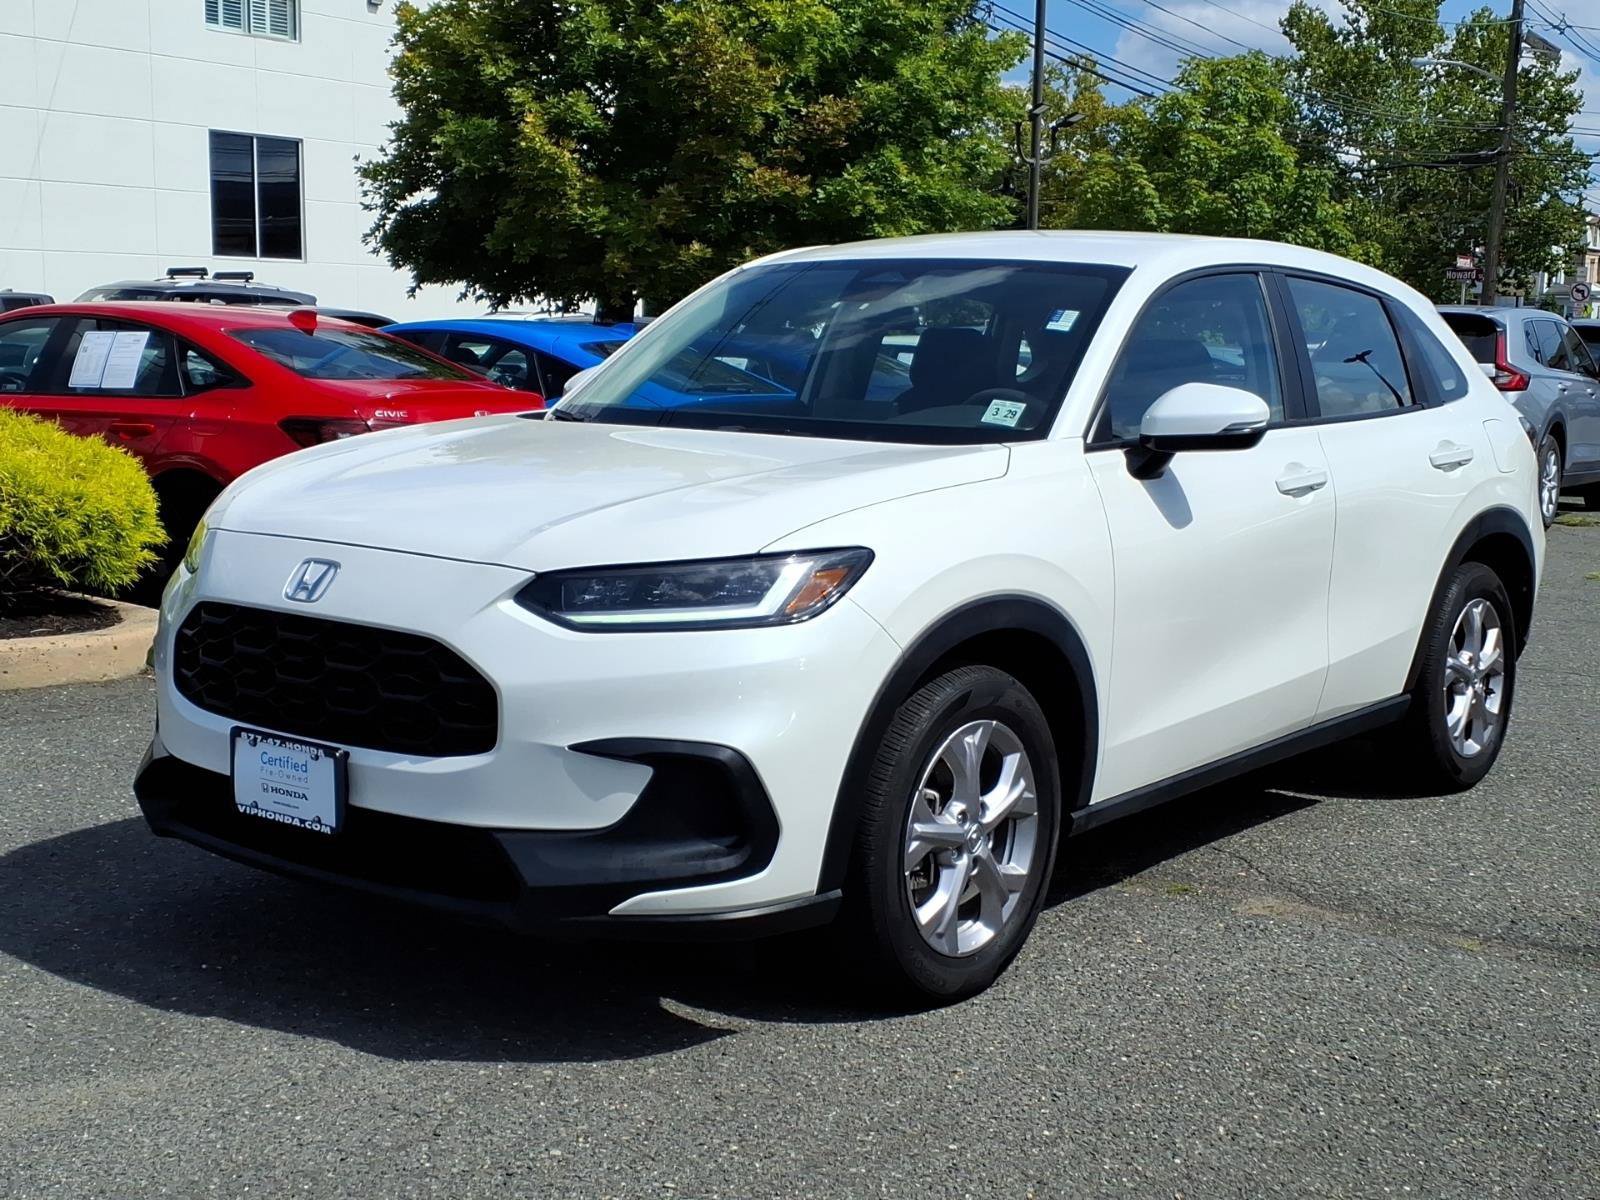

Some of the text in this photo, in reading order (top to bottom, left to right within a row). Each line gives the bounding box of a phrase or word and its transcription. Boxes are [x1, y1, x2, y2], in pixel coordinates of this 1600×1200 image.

[1446, 270, 1476, 280] Howard
[374, 409, 408, 418] CIVIC
[992, 407, 1017, 419] 3 29
[260, 751, 308, 773] Certified
[270, 785, 309, 801] HONDA
[237, 804, 331, 834] VIPHONDA.COM
